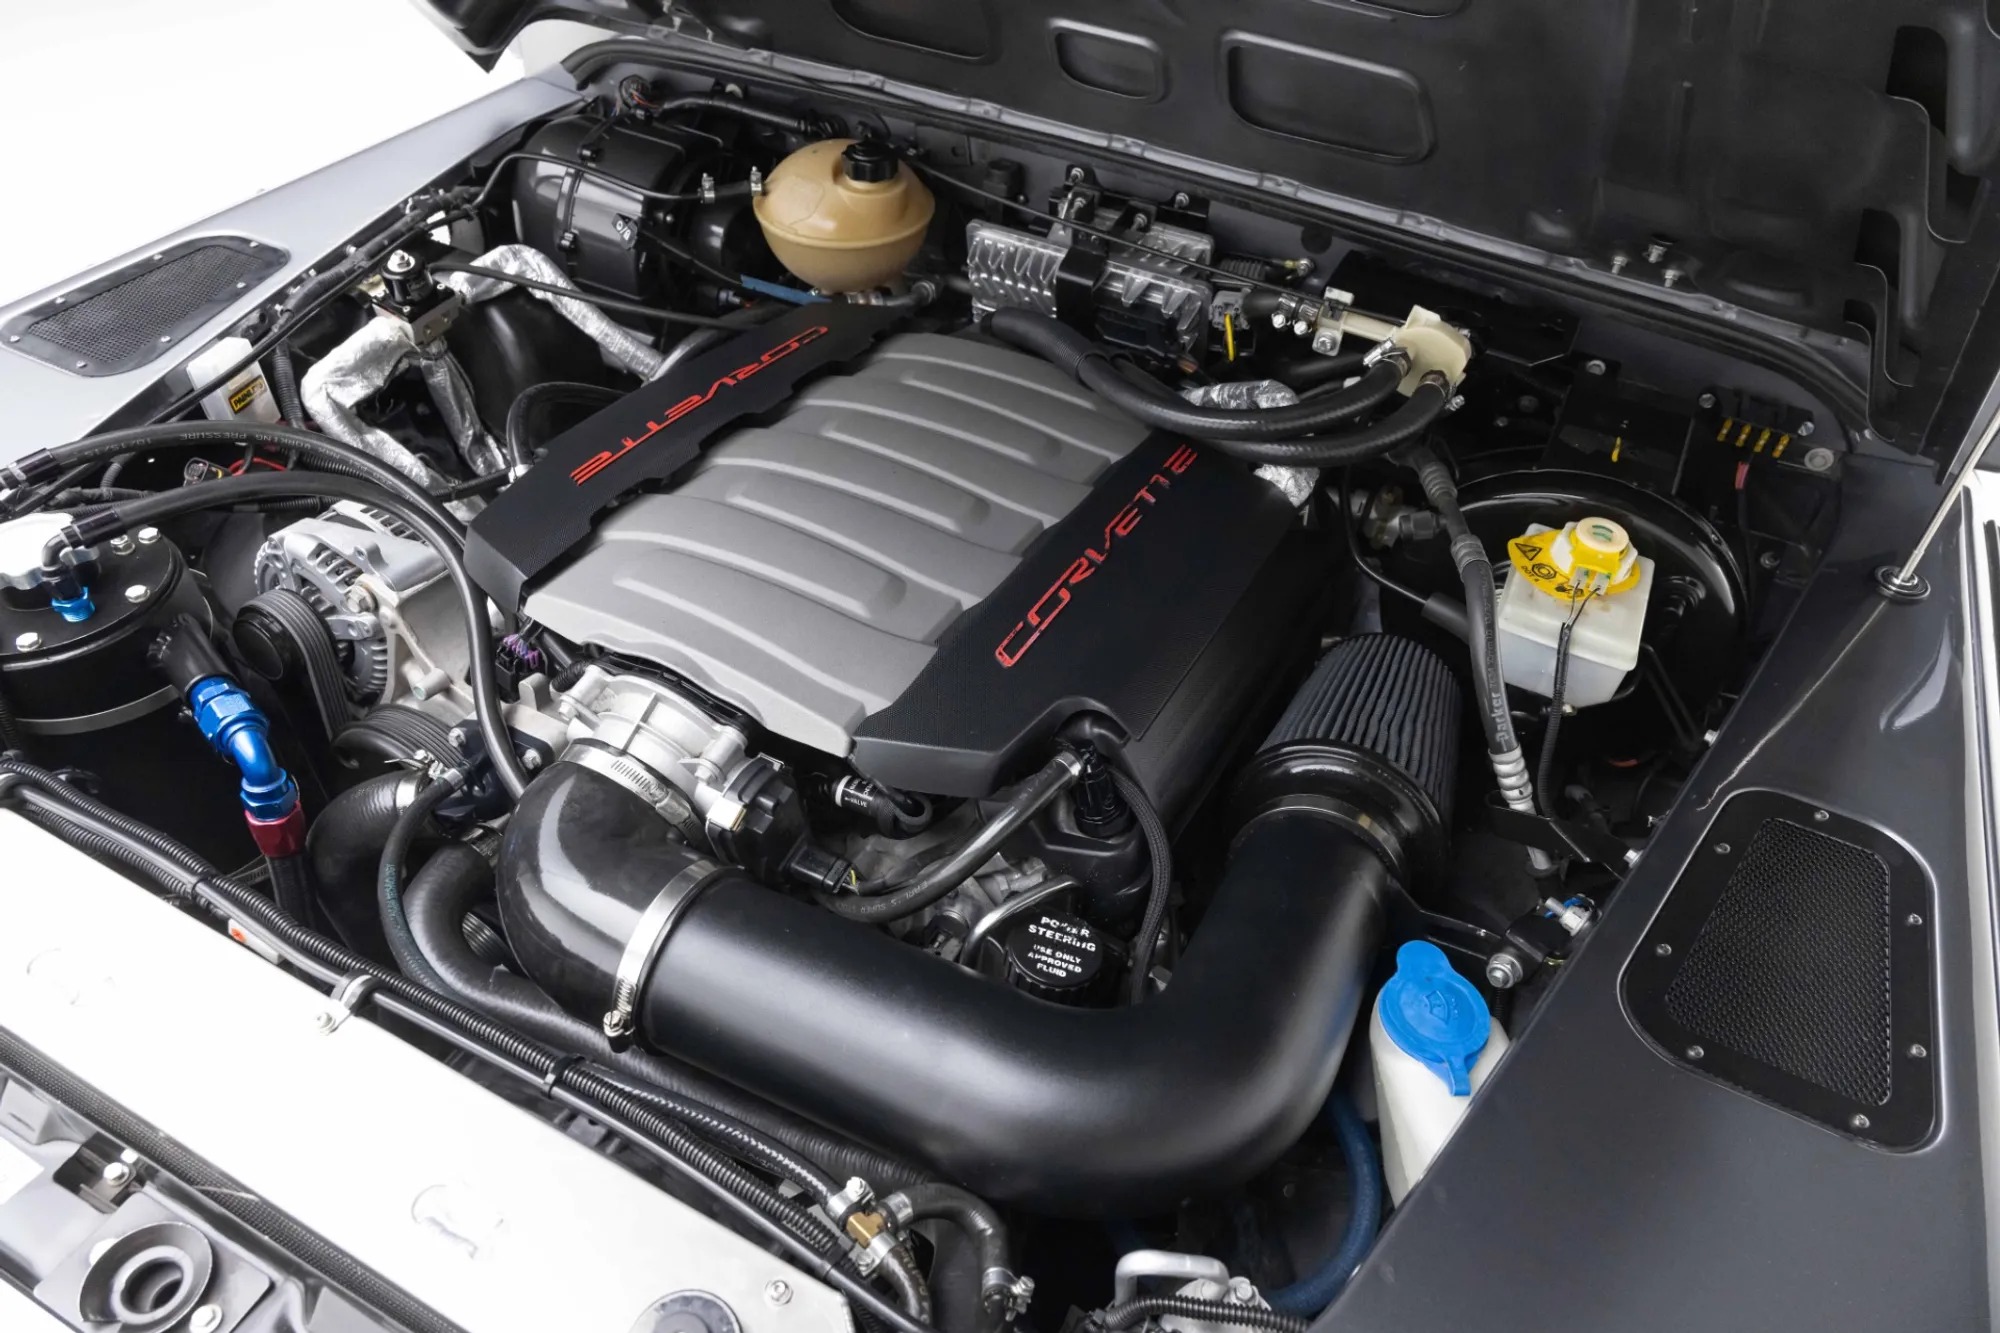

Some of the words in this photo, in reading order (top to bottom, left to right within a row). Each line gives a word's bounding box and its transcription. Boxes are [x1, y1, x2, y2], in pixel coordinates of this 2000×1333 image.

[570, 326, 828, 486] CORVETTE
[179, 431, 248, 441] PRESSURE
[996, 444, 1198, 667] CORVETTE
[1491, 693, 1508, 751] Parker
[1028, 924, 1097, 952] STEERING
[1027, 951, 1083, 974] APPROVED
[1033, 943, 1053, 956] USE
[1055, 950, 1082, 965] ONLY
[1036, 962, 1067, 978] FLUID
